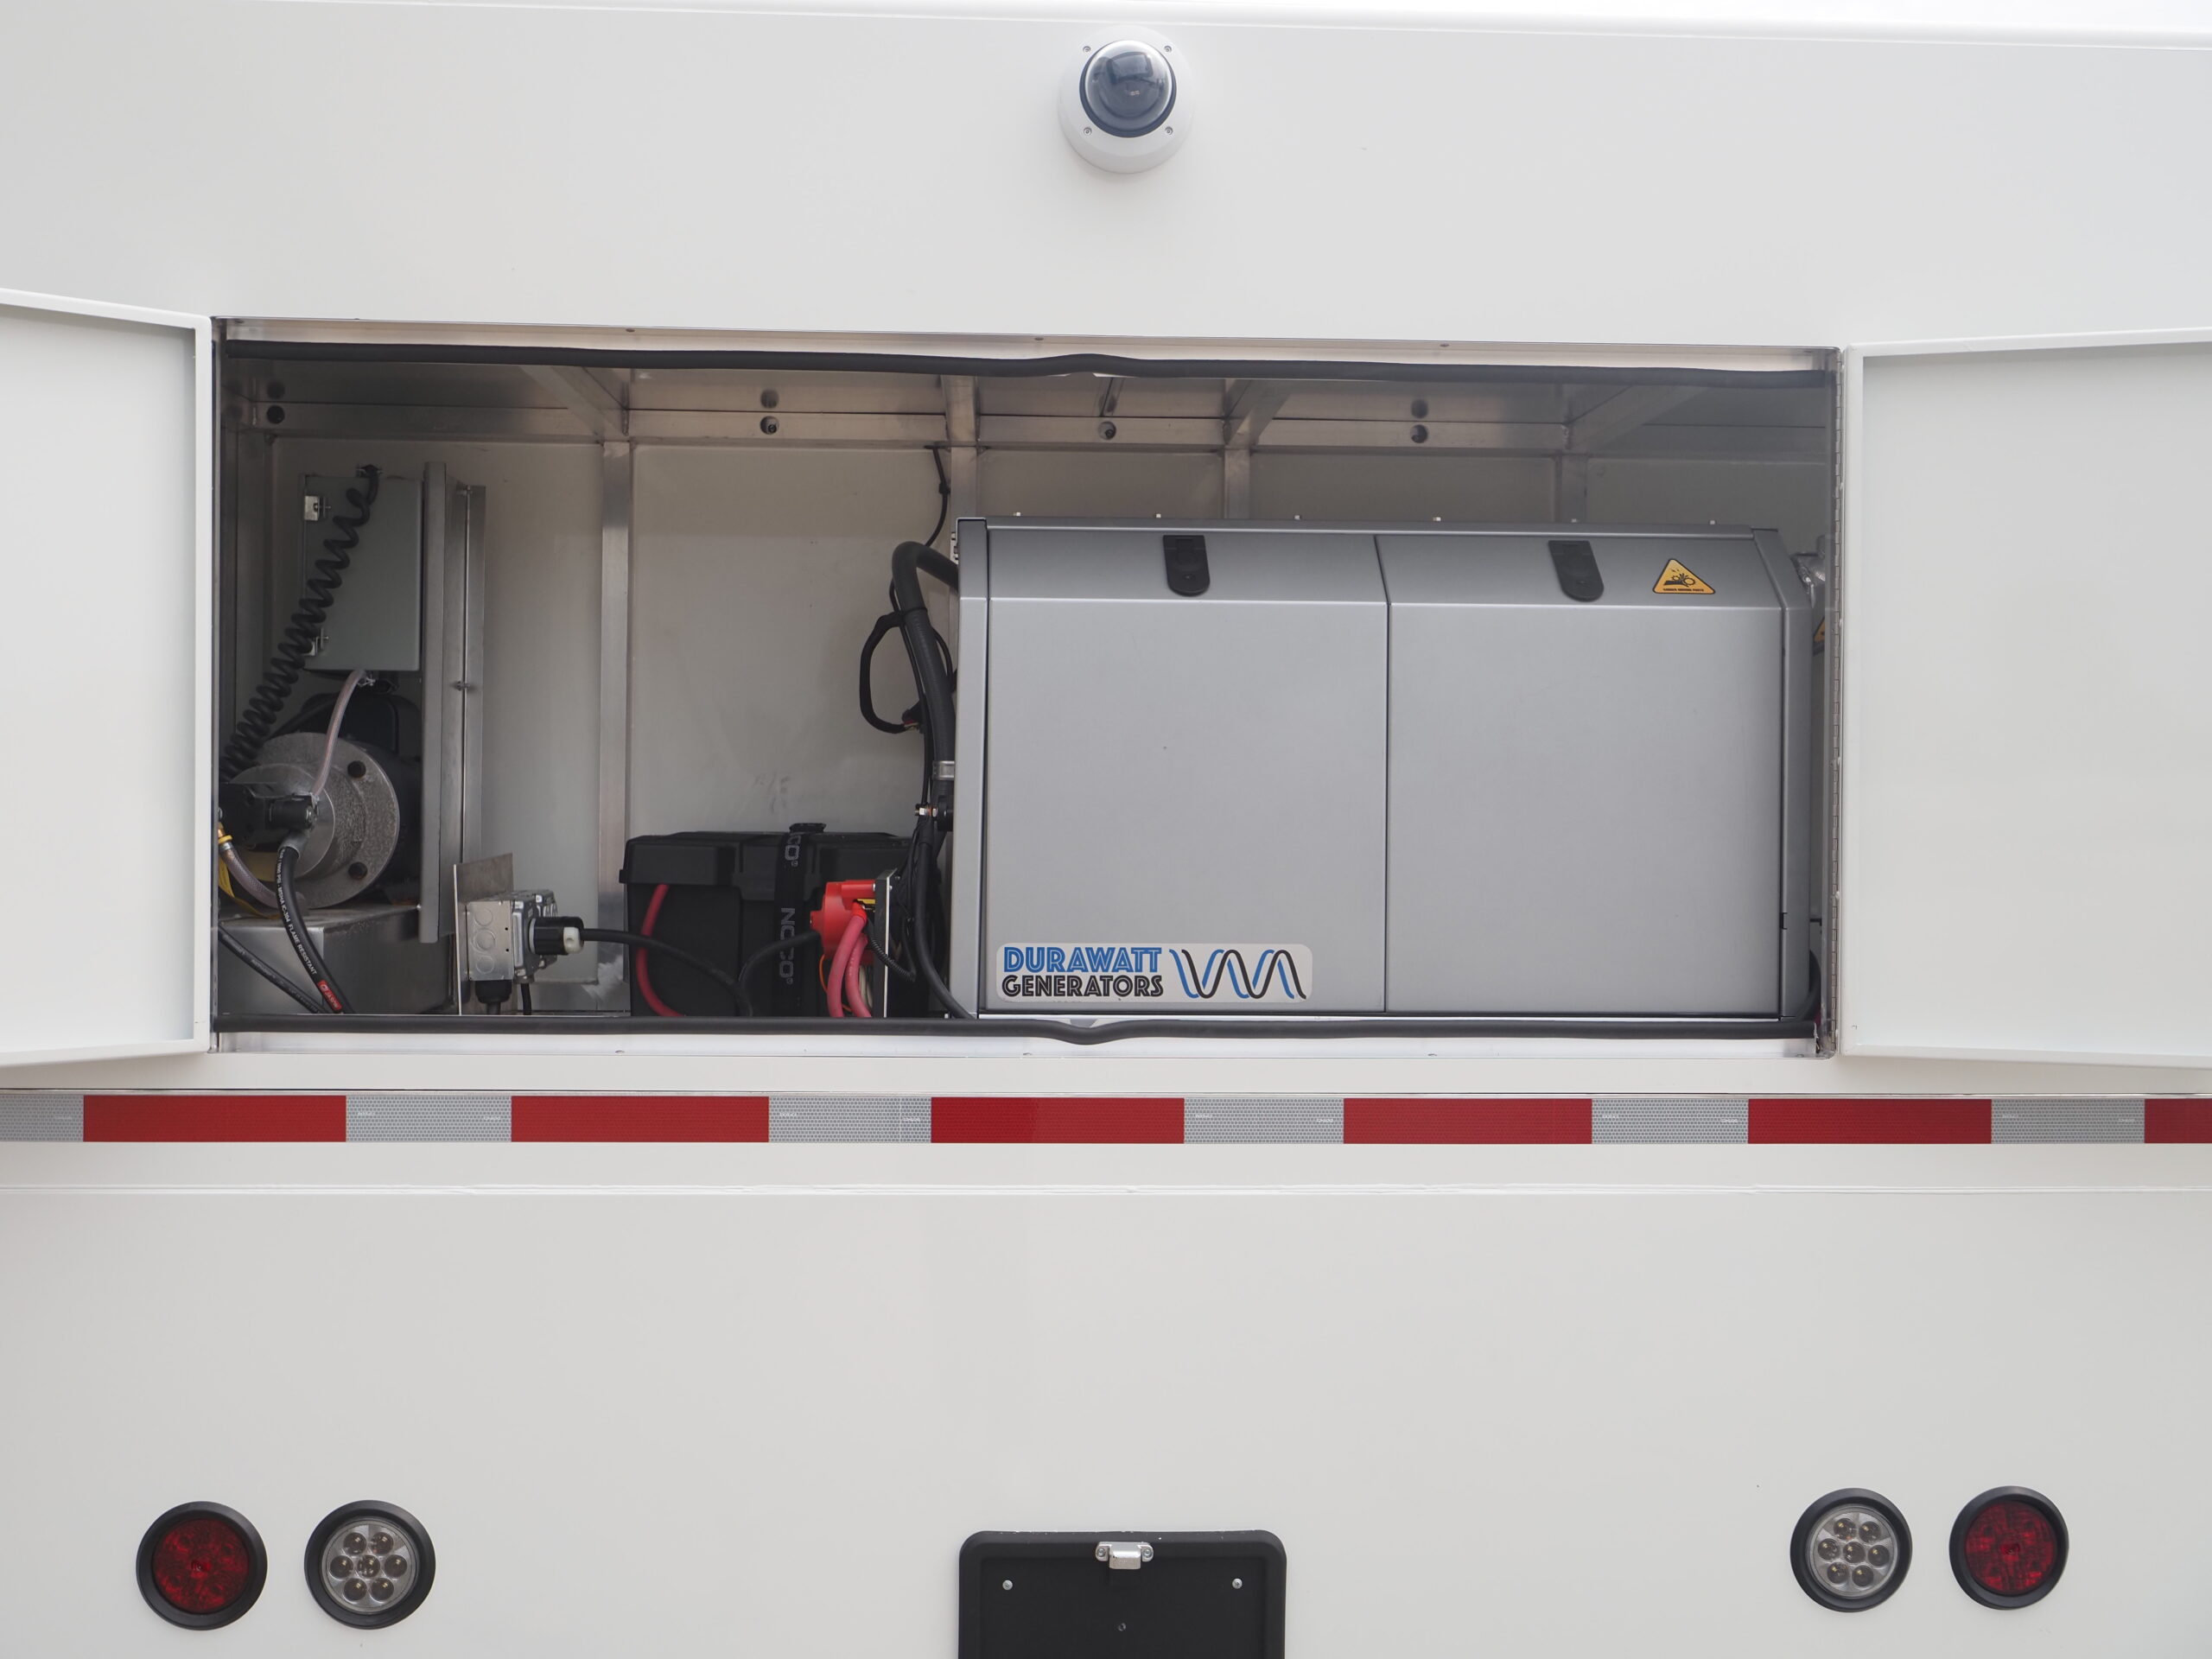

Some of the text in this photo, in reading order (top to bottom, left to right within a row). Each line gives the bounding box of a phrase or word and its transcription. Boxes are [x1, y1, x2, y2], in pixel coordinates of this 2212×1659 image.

[288, 924, 301, 944] FLAME
[297, 944, 318, 975] RESISTANT
[1003, 946, 1162, 973] DURAWATT
[1001, 974, 1164, 997] GENERATORS
